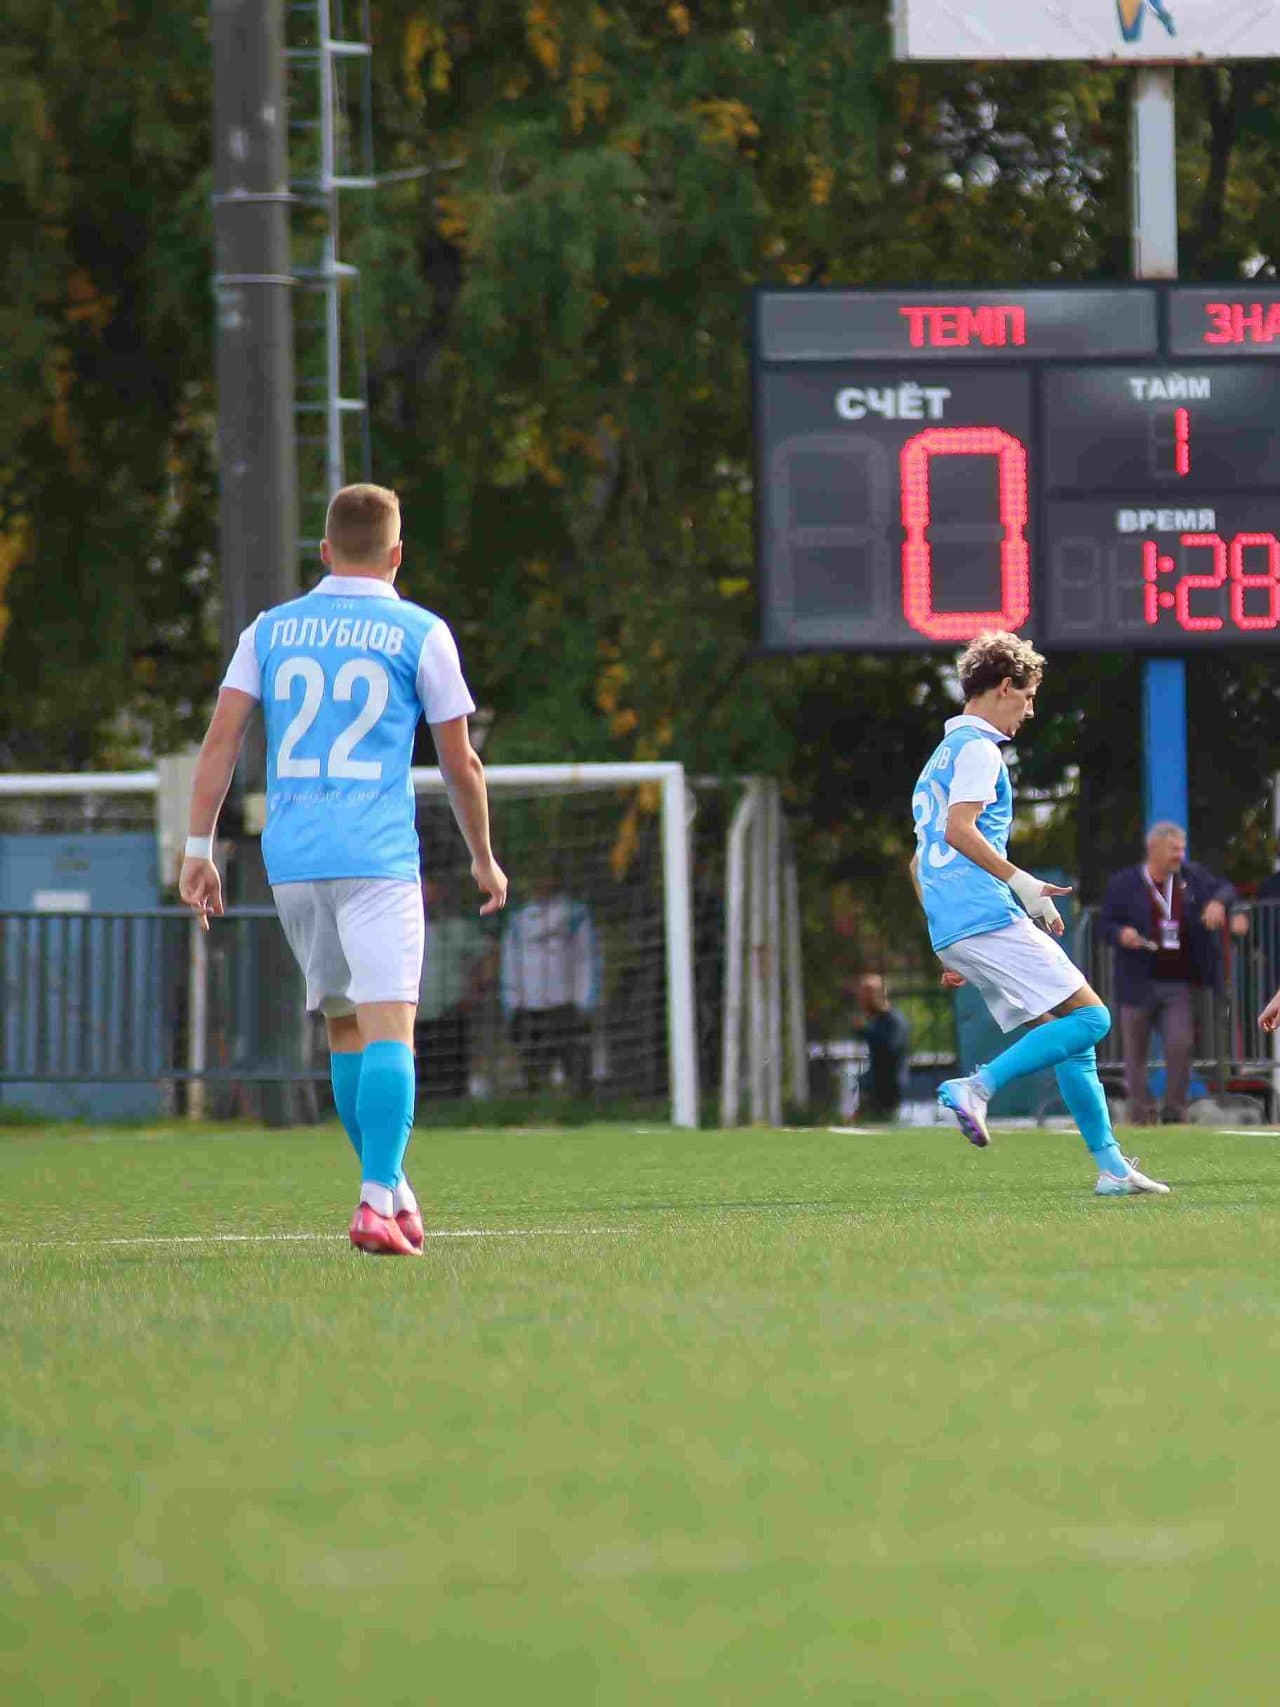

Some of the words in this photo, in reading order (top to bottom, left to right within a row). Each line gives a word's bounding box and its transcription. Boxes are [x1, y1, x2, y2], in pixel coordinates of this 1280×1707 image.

[899, 305, 1027, 347] ТЕМП
[836, 381, 952, 419] СЧЁТ
[1129, 371, 1211, 400] ТАЙМ
[1174, 406, 1191, 477] 1
[899, 426, 1030, 640] 0
[1116, 508, 1216, 533] ВРЕМЯ
[269, 617, 406, 657] ГОЛУБЦОВ
[273, 656, 390, 781] 22
